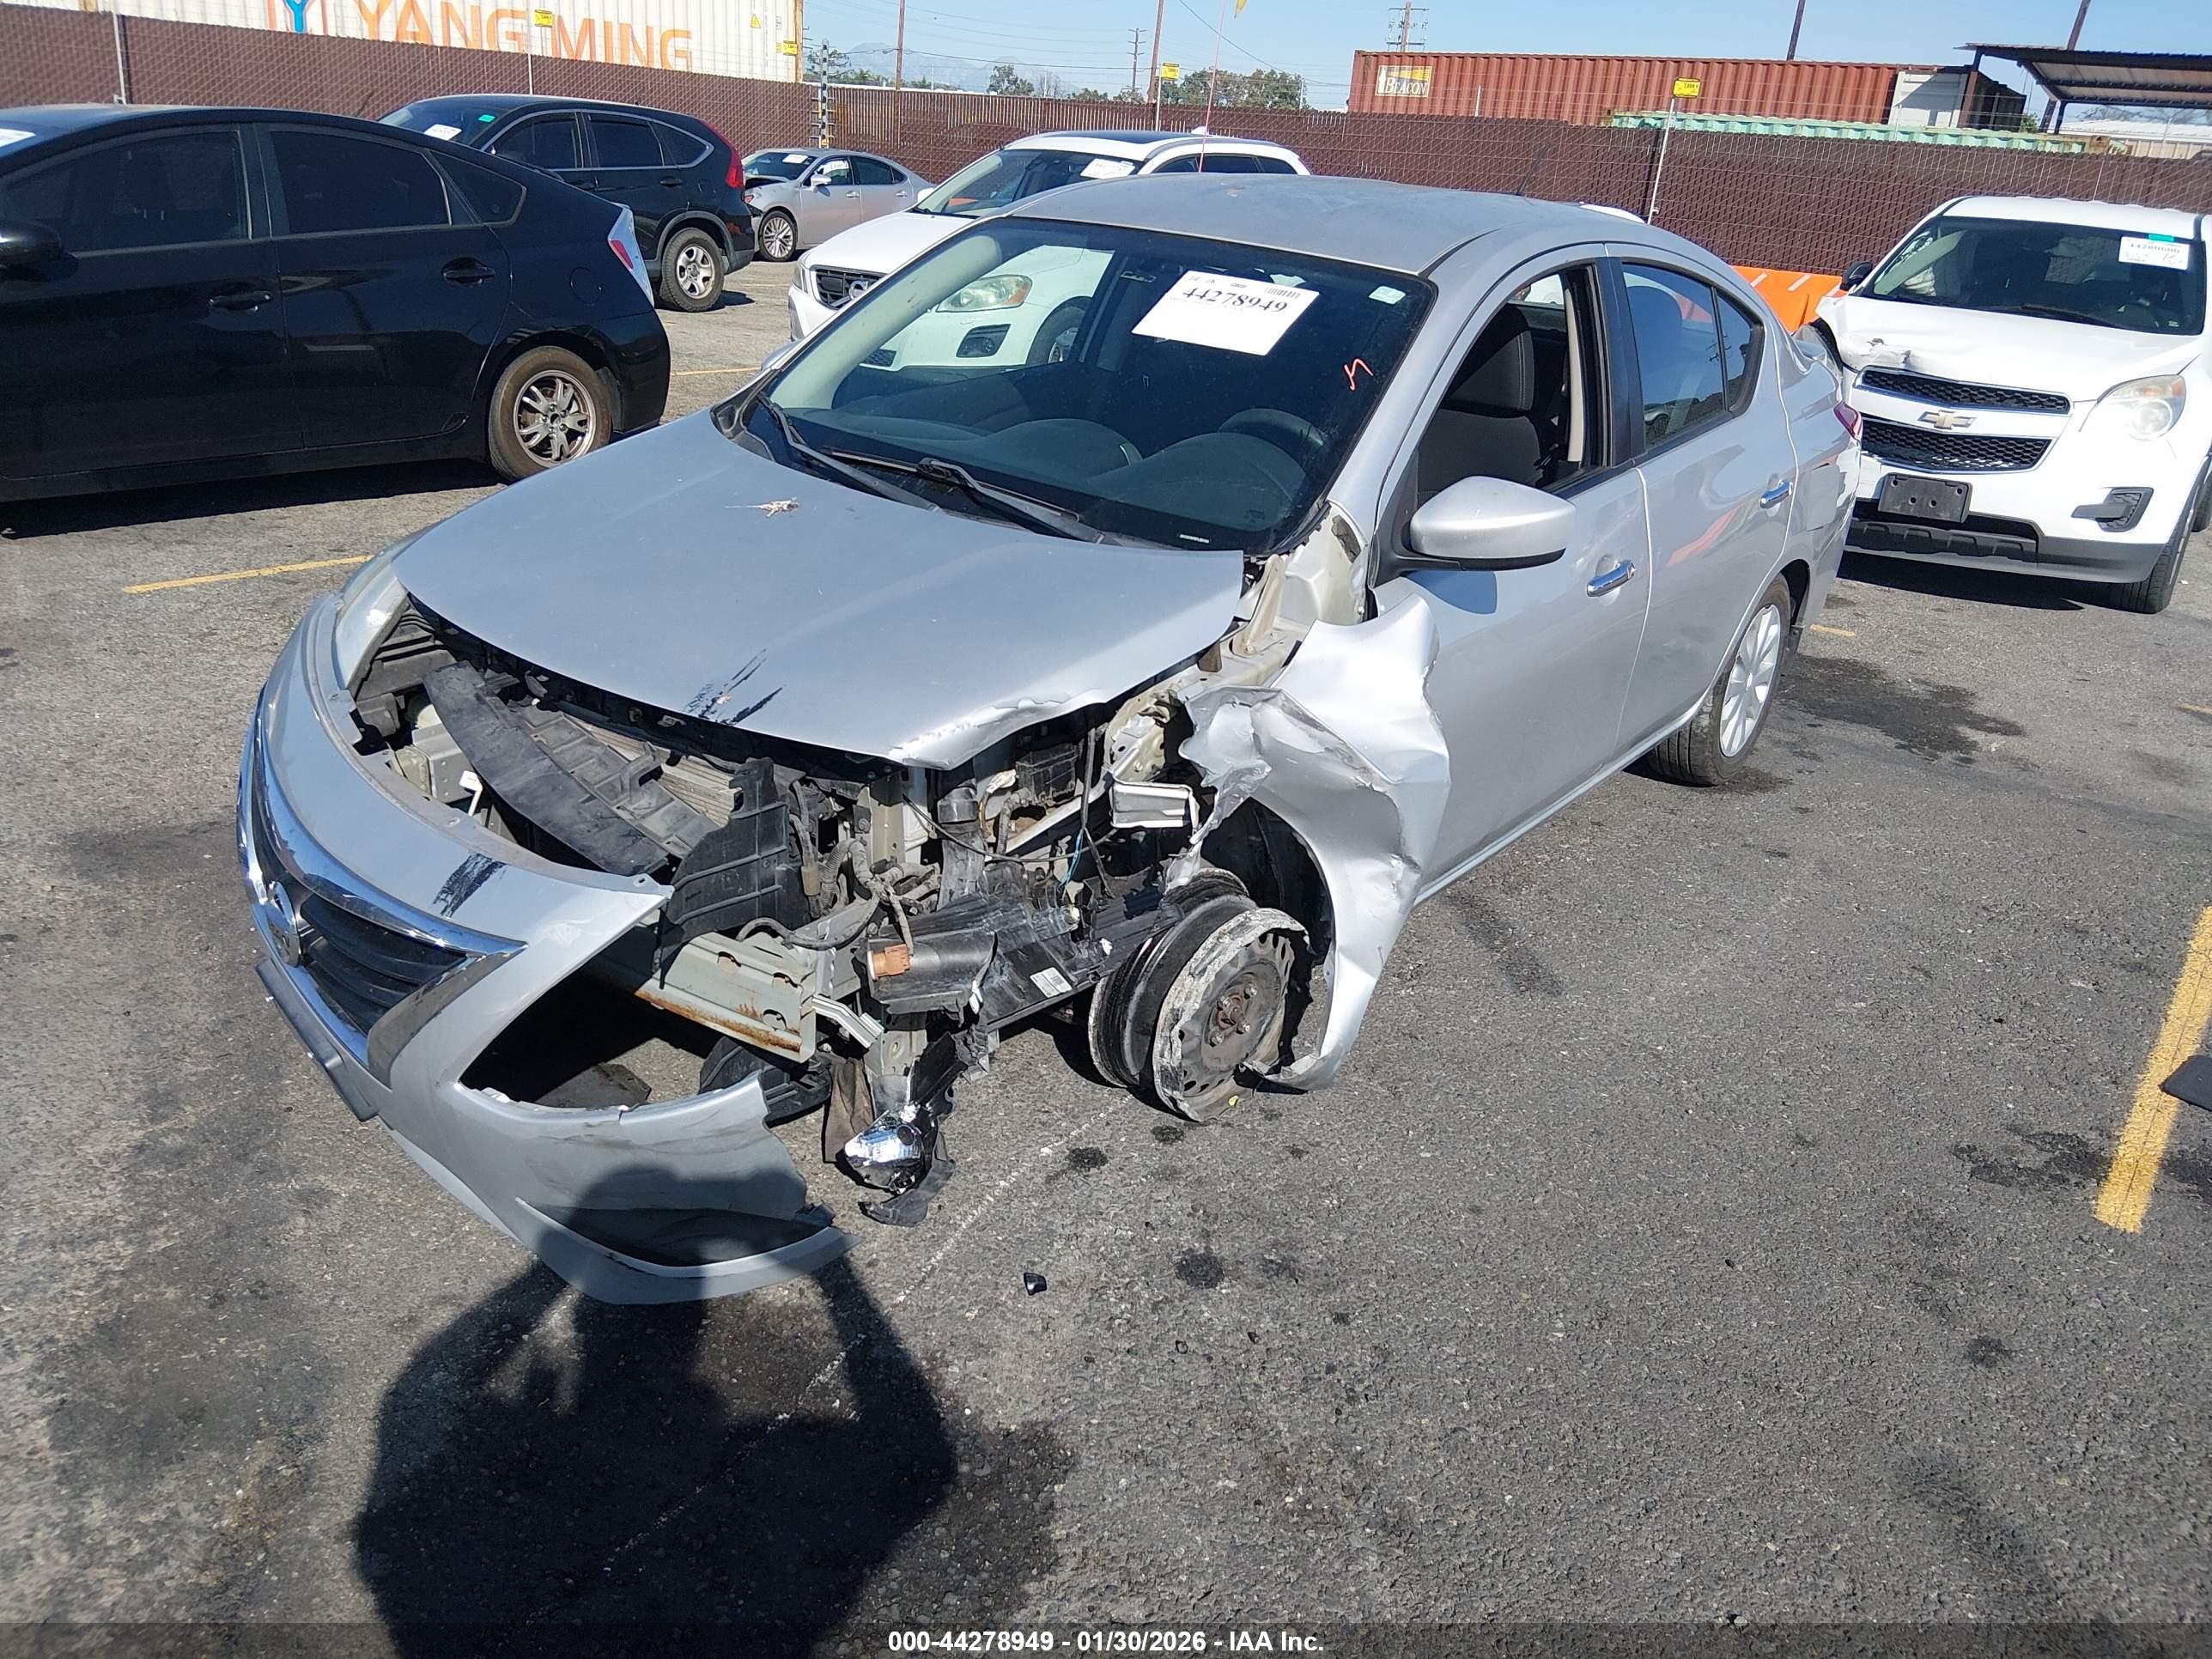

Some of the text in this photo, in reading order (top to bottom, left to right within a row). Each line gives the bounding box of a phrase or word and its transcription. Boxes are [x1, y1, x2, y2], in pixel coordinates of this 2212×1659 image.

[353, 0, 693, 70] YANG MING
[1384, 76, 1429, 94] BEACON
[1182, 286, 1289, 313] 44278949
